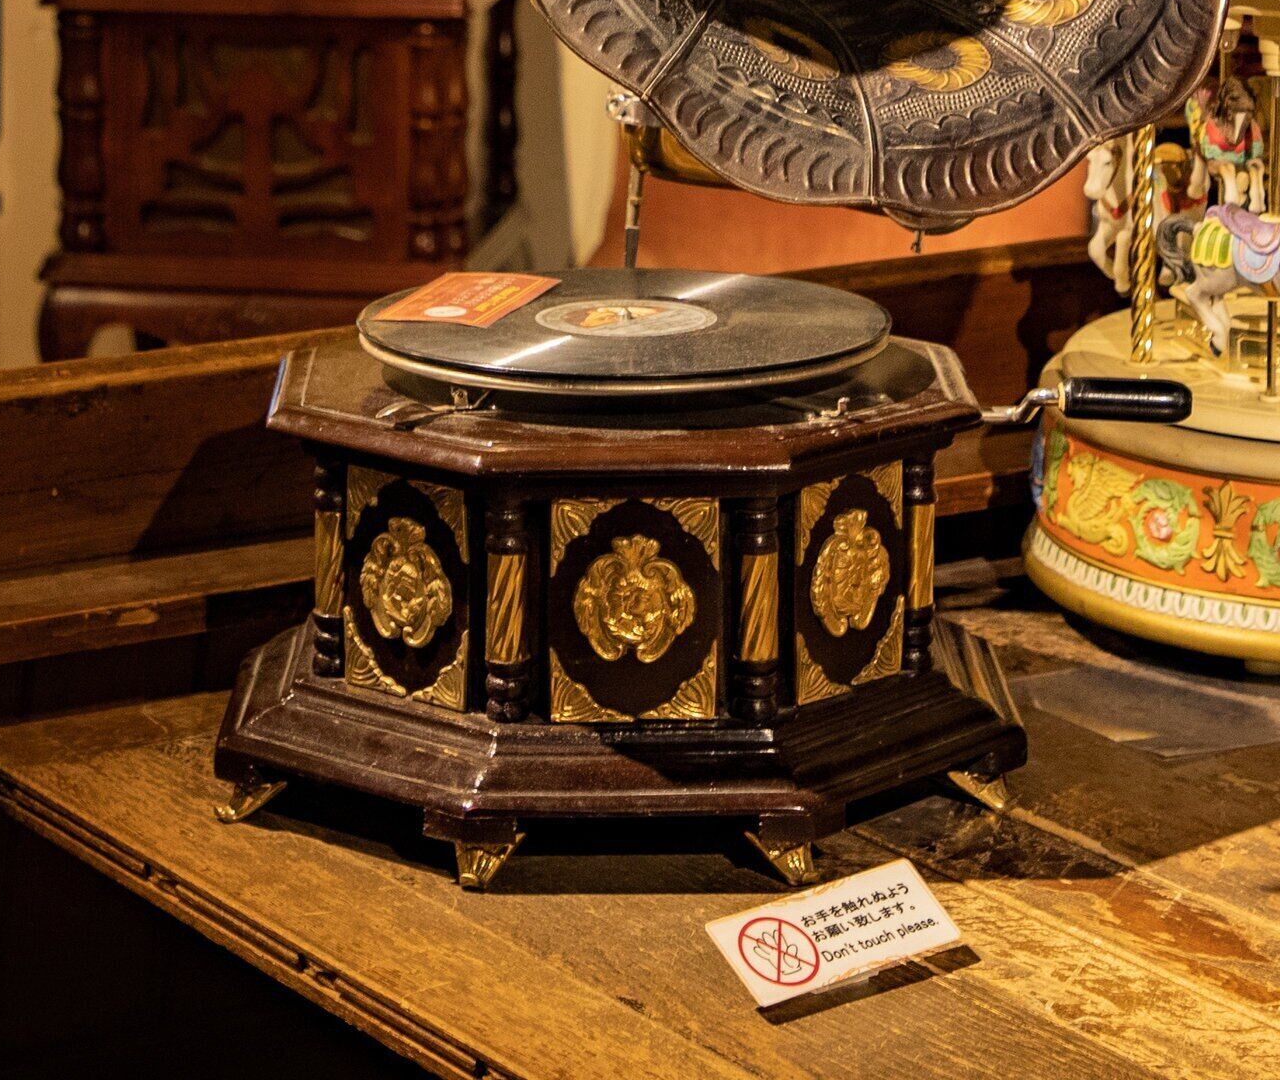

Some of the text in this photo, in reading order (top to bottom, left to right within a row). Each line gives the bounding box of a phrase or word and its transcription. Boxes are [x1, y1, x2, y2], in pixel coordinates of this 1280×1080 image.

[800, 882, 910, 928] お手を触れぬよう
[811, 904, 916, 943] お願い致します。
[821, 916, 940, 963] Don't touch please.
